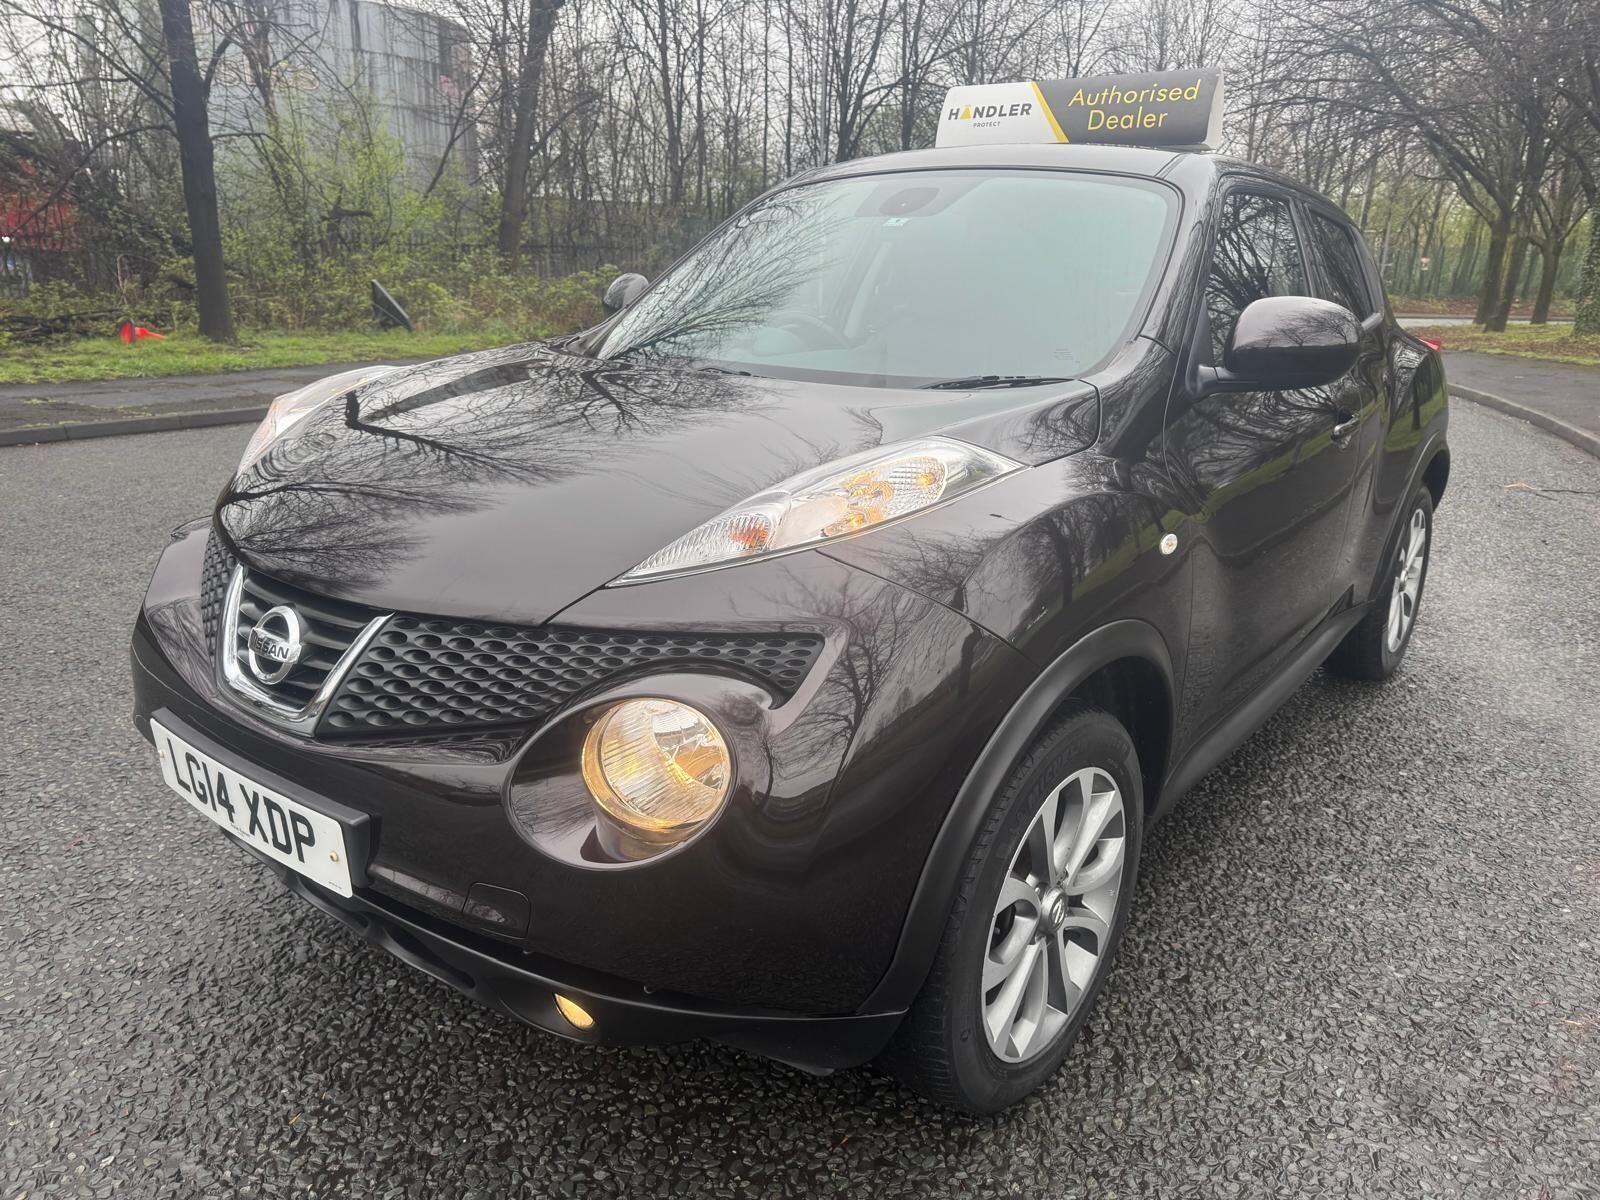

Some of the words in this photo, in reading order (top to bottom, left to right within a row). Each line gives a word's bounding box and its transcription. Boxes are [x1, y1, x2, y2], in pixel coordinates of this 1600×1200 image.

[1068, 79, 1201, 107] Authorised
[948, 103, 1032, 120] HANDLER
[1087, 106, 1168, 130] Dealer
[250, 630, 289, 659] NISSAN
[166, 737, 235, 823] LG14
[239, 783, 316, 864] XDP
